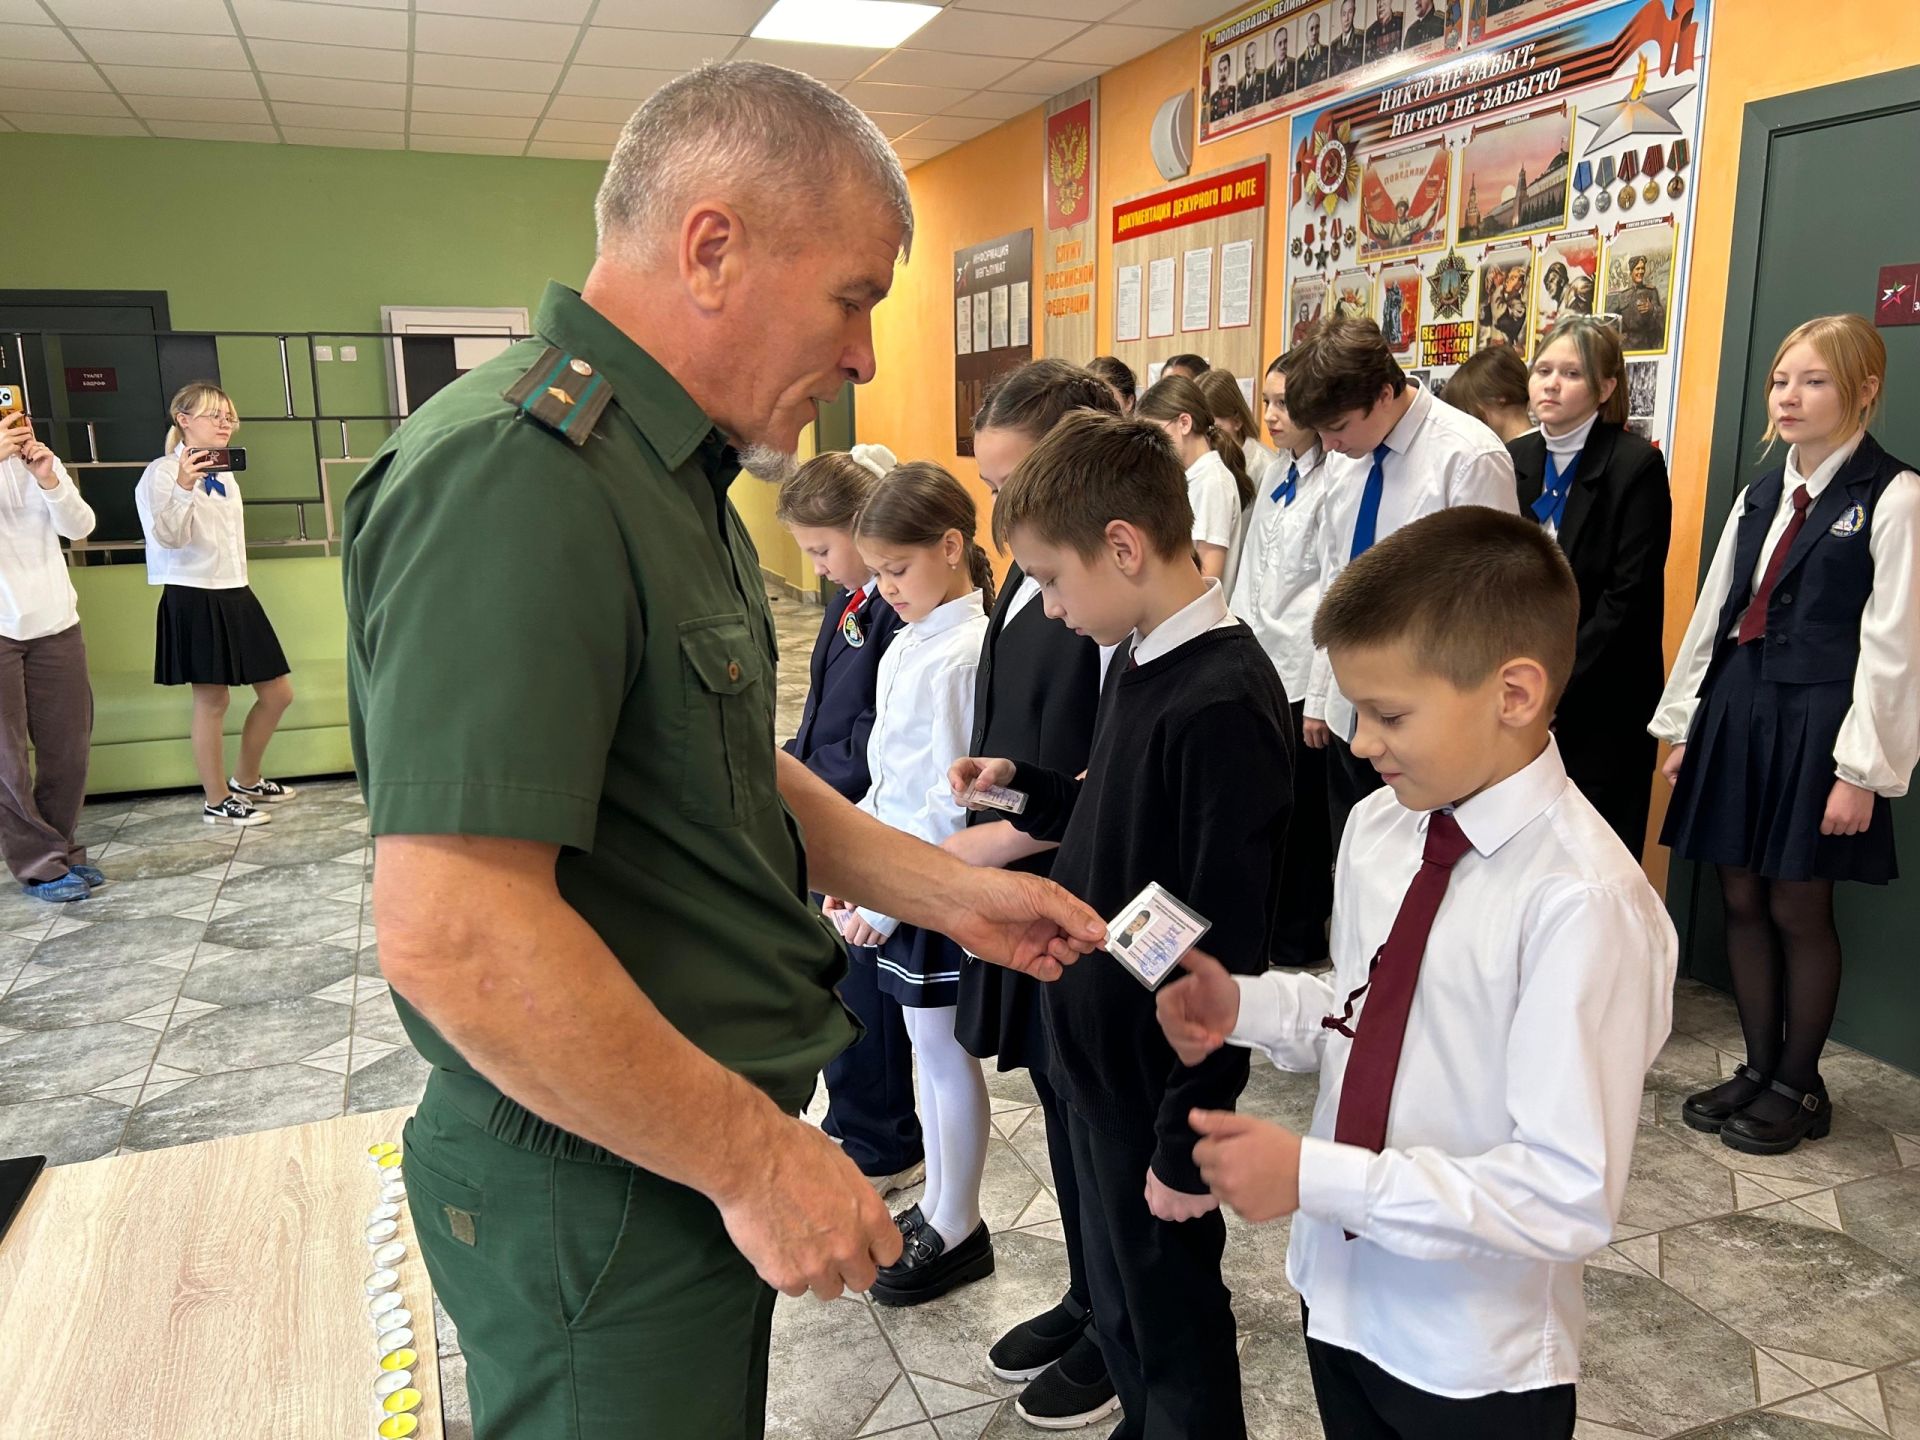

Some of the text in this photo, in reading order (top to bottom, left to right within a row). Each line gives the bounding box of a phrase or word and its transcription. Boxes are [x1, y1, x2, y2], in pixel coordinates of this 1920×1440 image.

[1215, 7, 1270, 45] ПОЛКОВОДЦЫ
[1378, 42, 1536, 113] НИКТО НЕ ЗАБЫТ,
[1389, 67, 1561, 138] НИЧТО НЕ ЗАБЫТО
[1118, 178, 1257, 234] ДОКУМЕНТАЦИЯ ДЕЖУРНОГО ПО РОТЕ
[1045, 260, 1094, 291] РОССИЙСКОЙ
[1421, 321, 1474, 341] ВЕЛИКАЯ
[1424, 337, 1469, 355] ПОБЕДА
[1422, 352, 1469, 367] 1941-1945
